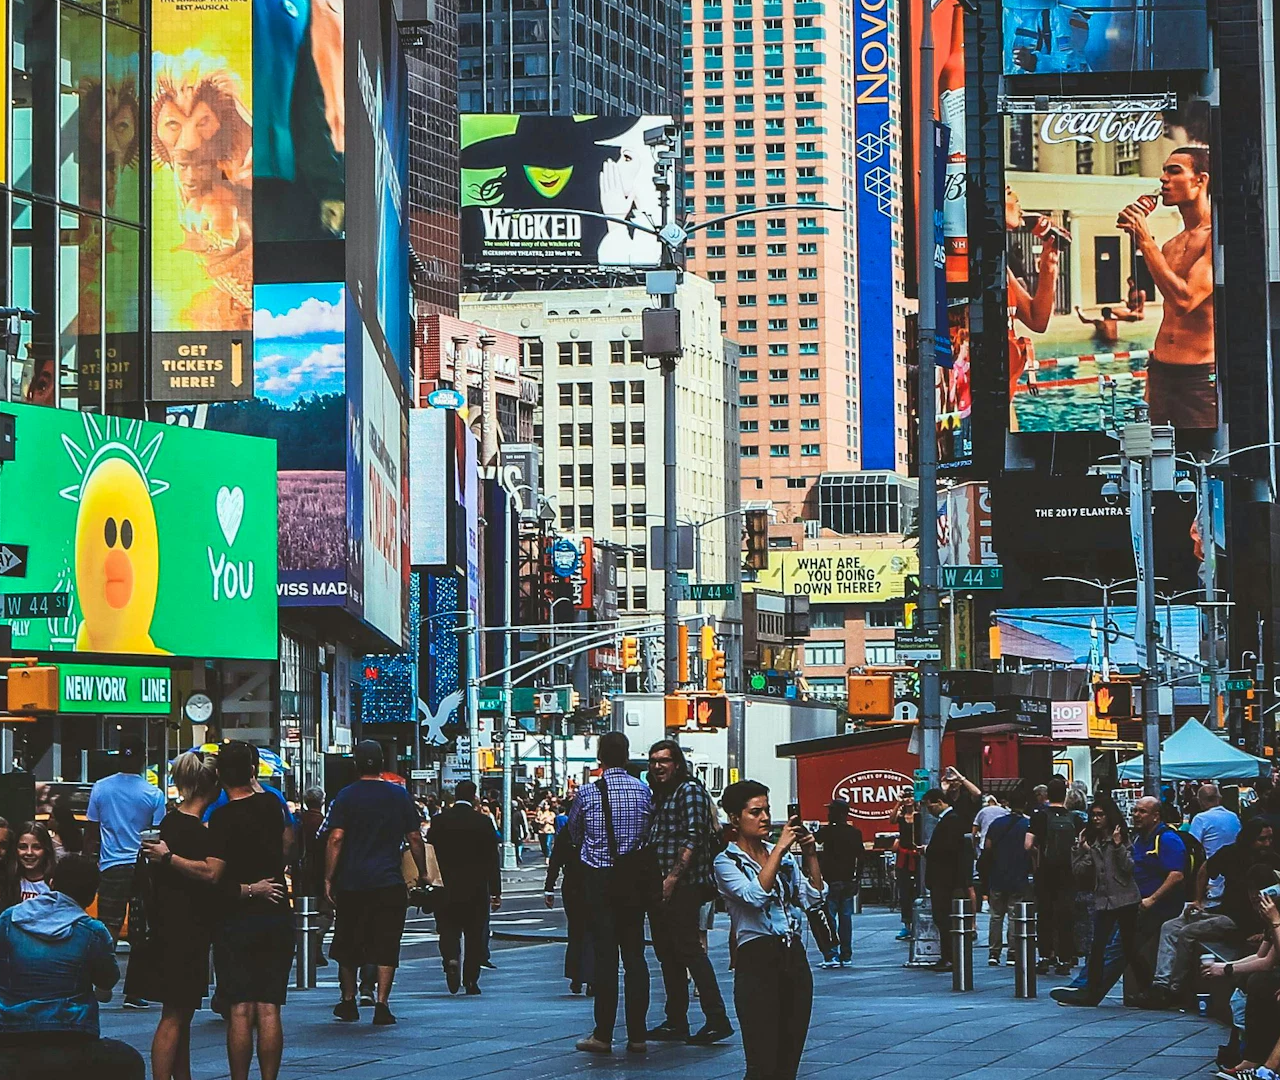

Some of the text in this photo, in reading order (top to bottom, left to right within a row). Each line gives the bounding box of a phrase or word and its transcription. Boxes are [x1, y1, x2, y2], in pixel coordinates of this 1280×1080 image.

[194, 3, 230, 11] MUSICAL
[178, 344, 208, 357] GET
[162, 359, 224, 372] TICKETS
[170, 375, 216, 388] HERE!
[1035, 508, 1053, 518] THE
[1055, 508, 1077, 518] 2017
[1079, 506, 1124, 517] ELANTRA
[797, 556, 860, 570] WHAT ARE
[207, 545, 255, 602] YOU
[807, 569, 875, 582] YOU DOING
[945, 567, 1000, 586] W 44 ST
[692, 587, 703, 599] W
[707, 586, 721, 598] 44
[794, 581, 882, 595] DOWN THERE?
[8, 597, 21, 615] W
[29, 596, 48, 614] 44
[65, 675, 166, 703] NEW YORK LINE
